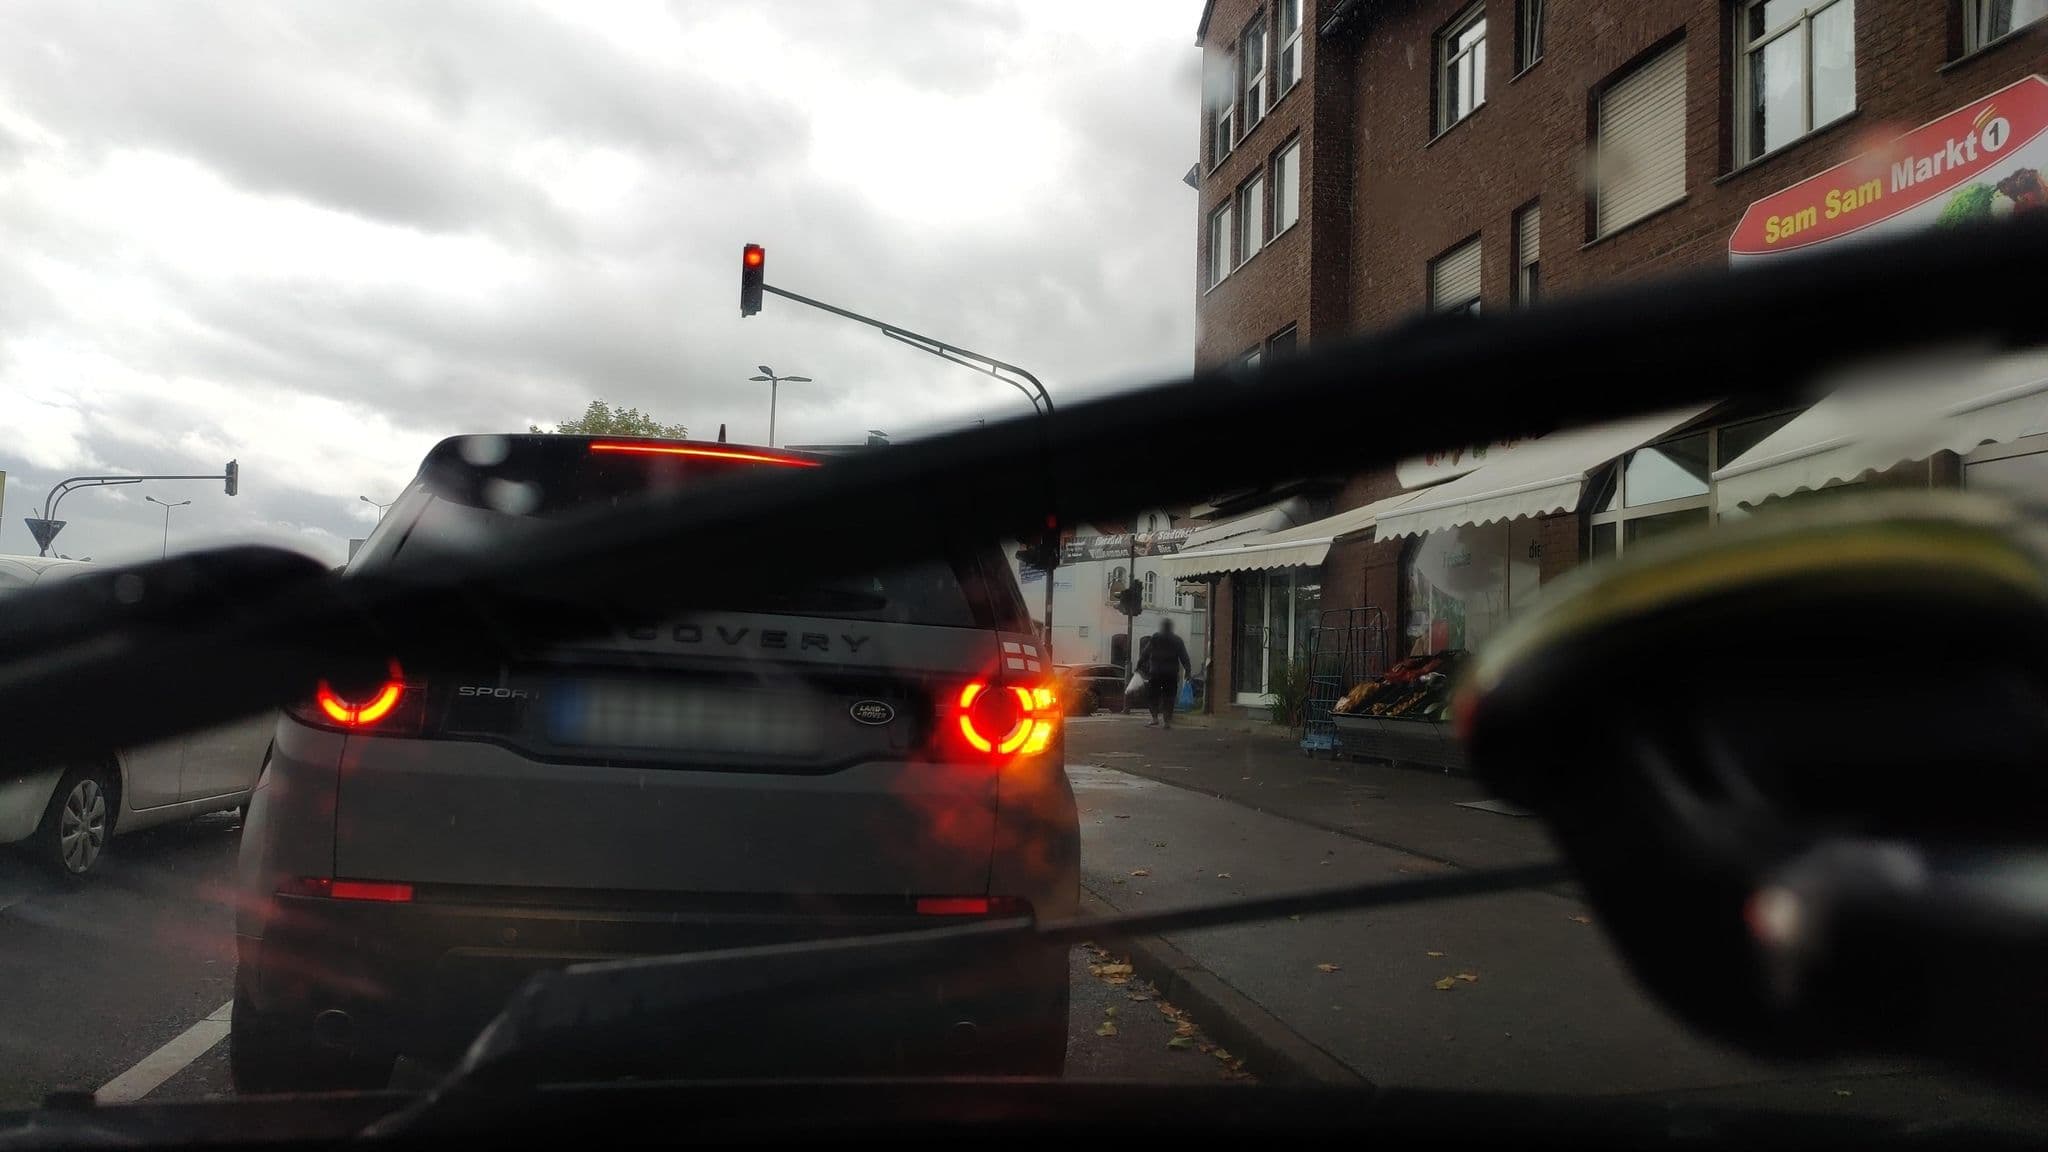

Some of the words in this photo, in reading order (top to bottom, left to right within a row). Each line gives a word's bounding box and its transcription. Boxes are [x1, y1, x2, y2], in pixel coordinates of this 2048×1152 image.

[1765, 205, 1817, 244] Sam
[1825, 177, 1882, 221] Sam
[1891, 130, 1978, 193] Markt
[626, 623, 870, 653] COVERY
[458, 685, 538, 699] SPOR
